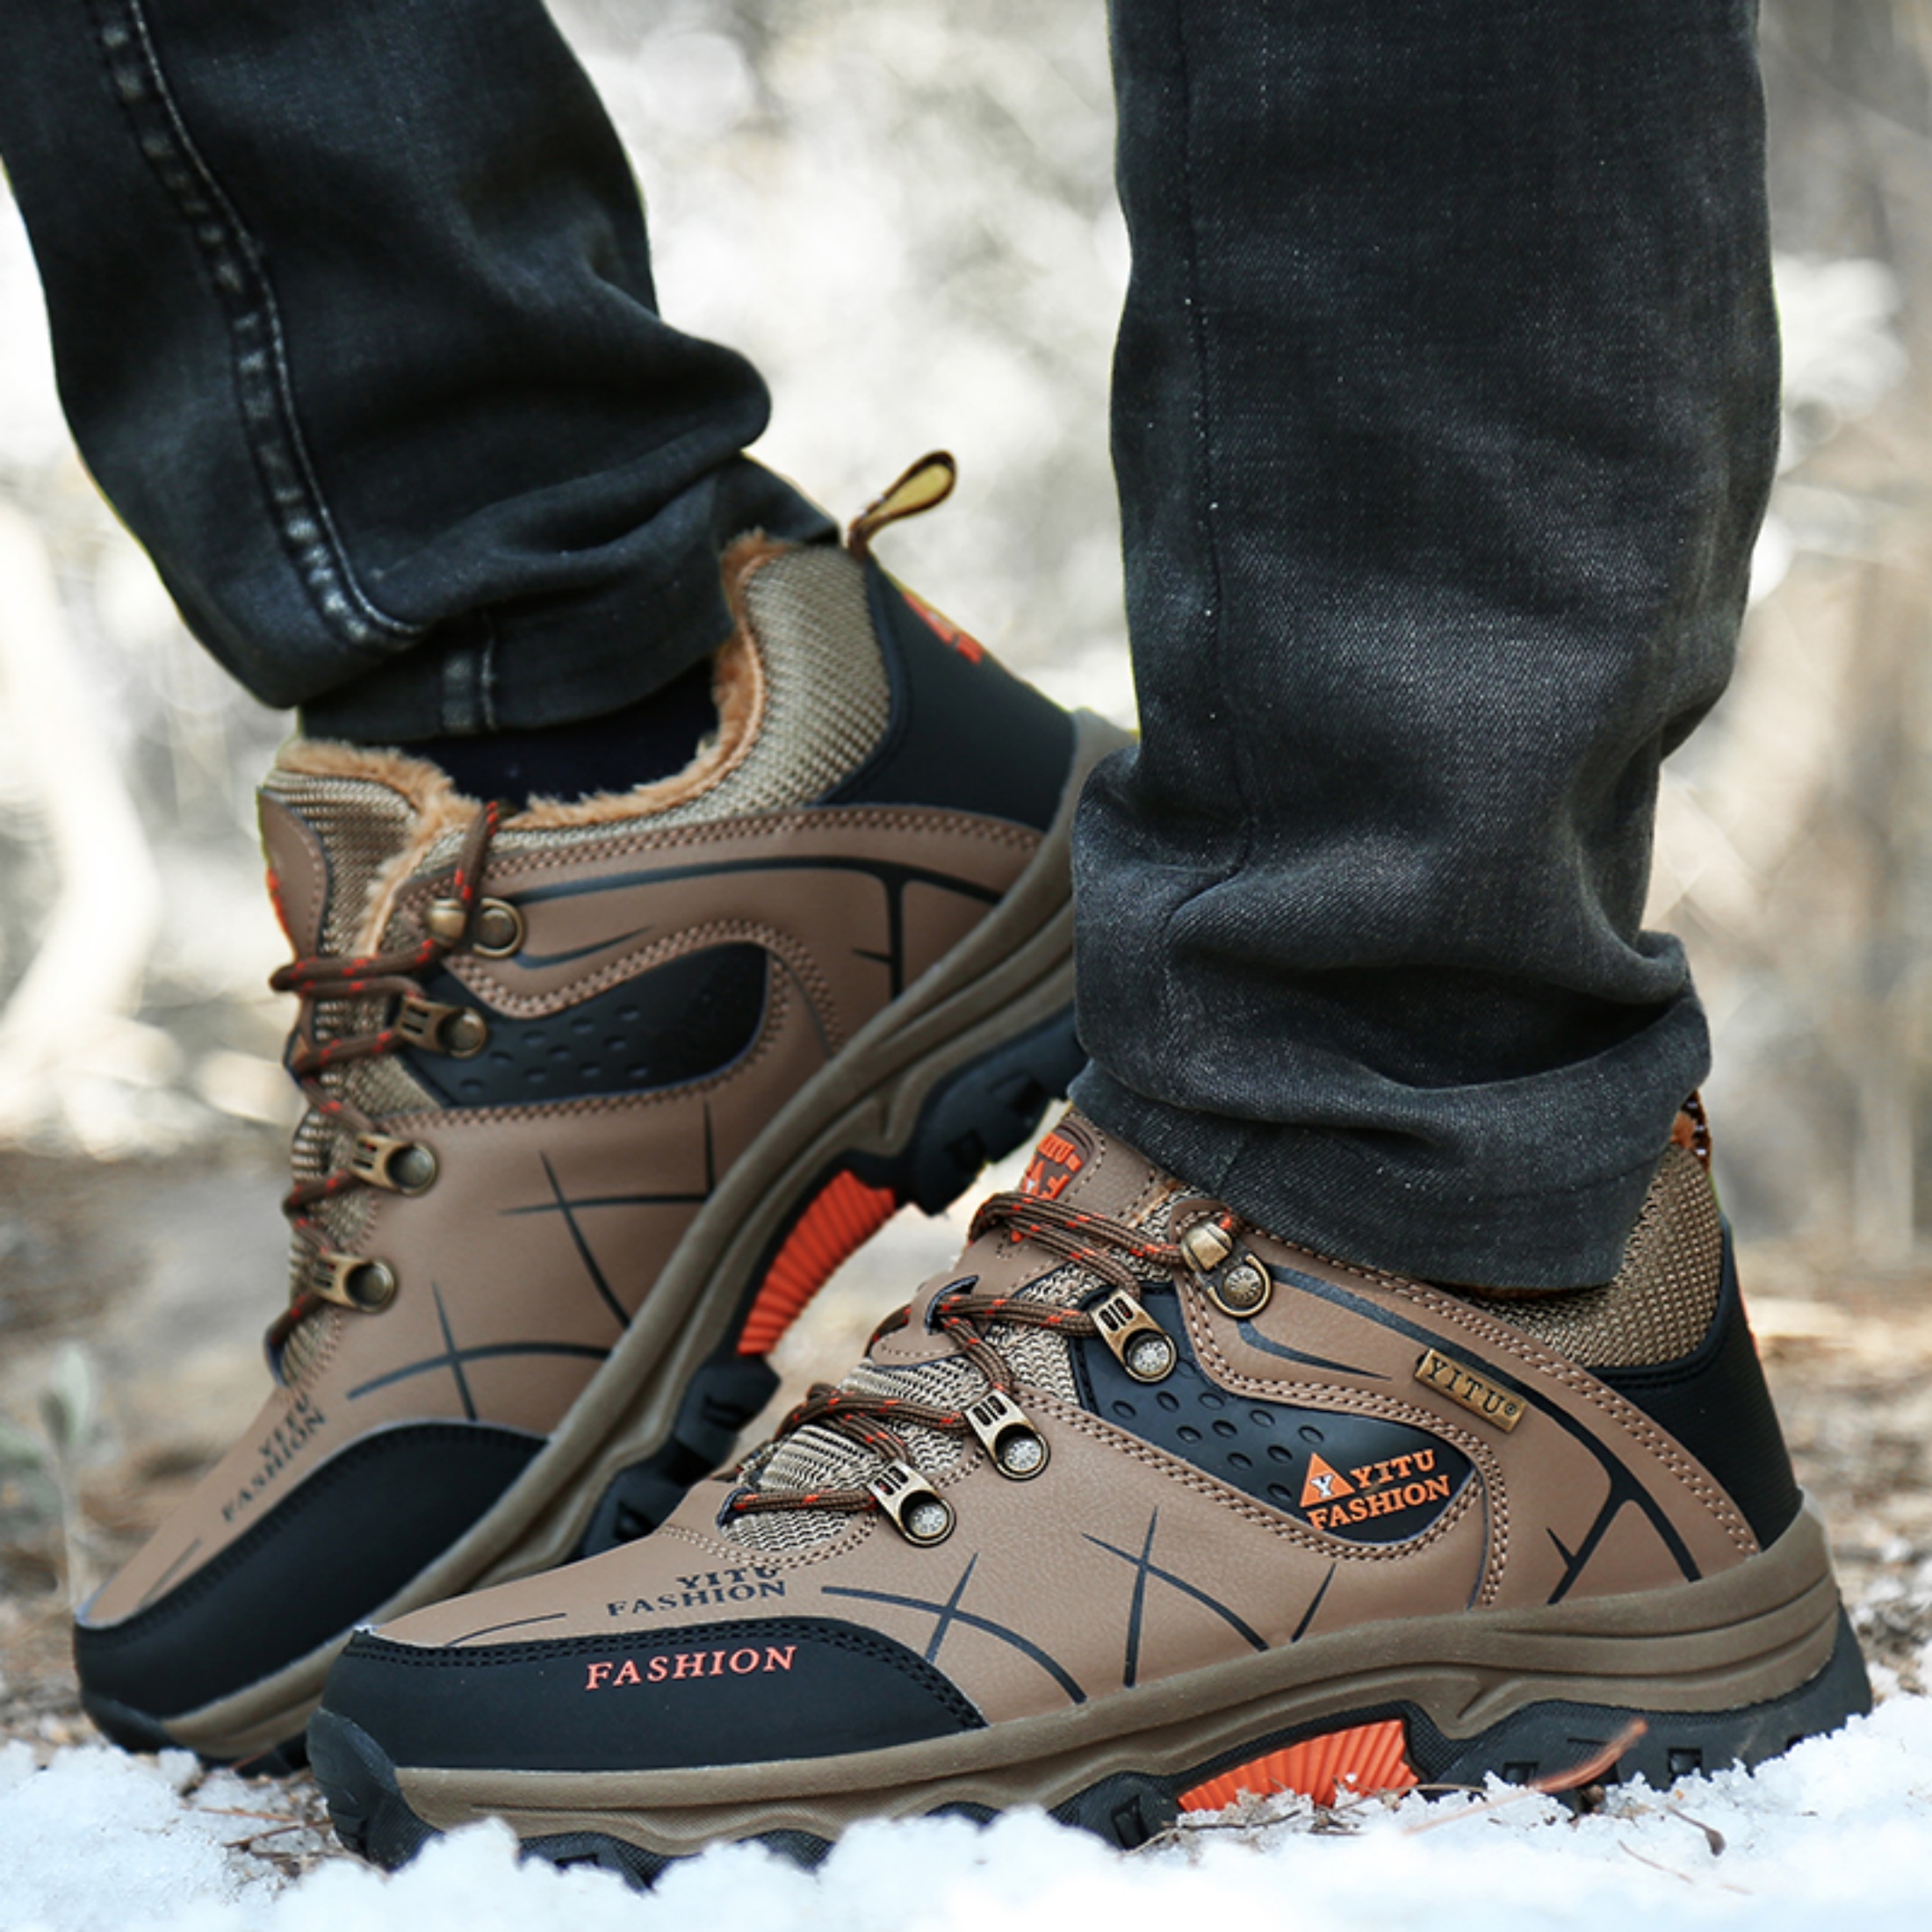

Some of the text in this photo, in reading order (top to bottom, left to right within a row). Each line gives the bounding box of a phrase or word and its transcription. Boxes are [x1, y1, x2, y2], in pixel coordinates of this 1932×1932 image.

[1350, 1449, 1435, 1489] YITU
[1306, 1474, 1450, 1531] FASHION
[607, 1581, 785, 1616] FASHION
[676, 1567, 778, 1590] YITU
[585, 1645, 797, 1690] FASHION
